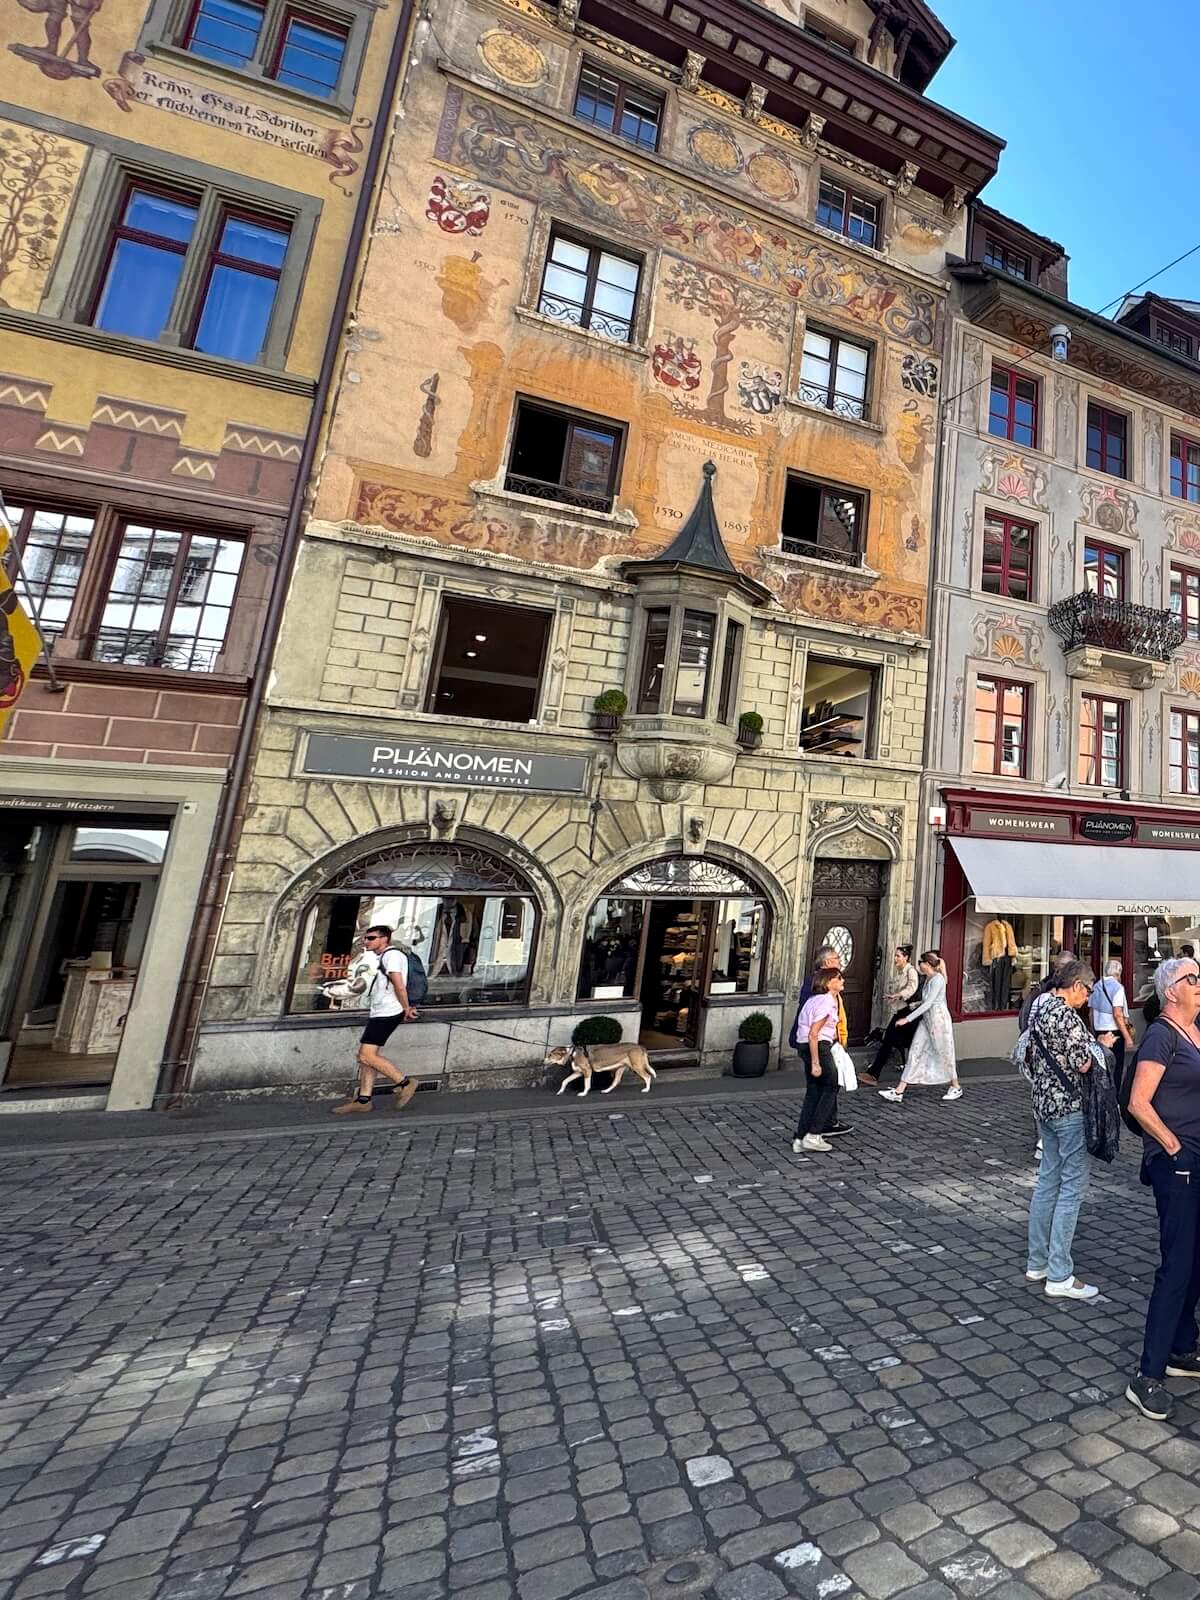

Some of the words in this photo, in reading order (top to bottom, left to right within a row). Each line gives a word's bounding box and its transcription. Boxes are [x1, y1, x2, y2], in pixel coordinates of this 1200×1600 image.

[655, 506, 684, 520] 1530
[723, 520, 749, 534] 1895
[372, 746, 533, 776] PHÄNOMEN
[370, 766, 429, 778] FASHION
[435, 771, 461, 780] AND
[467, 775, 530, 786] LIFESTYLE
[0, 797, 42, 808] unfthaus
[45, 801, 63, 809] zur
[988, 817, 1056, 831] WOMENSWEAR
[1085, 819, 1133, 831] PHÄNOMEN
[1116, 903, 1172, 914] PHÄNOMEN
